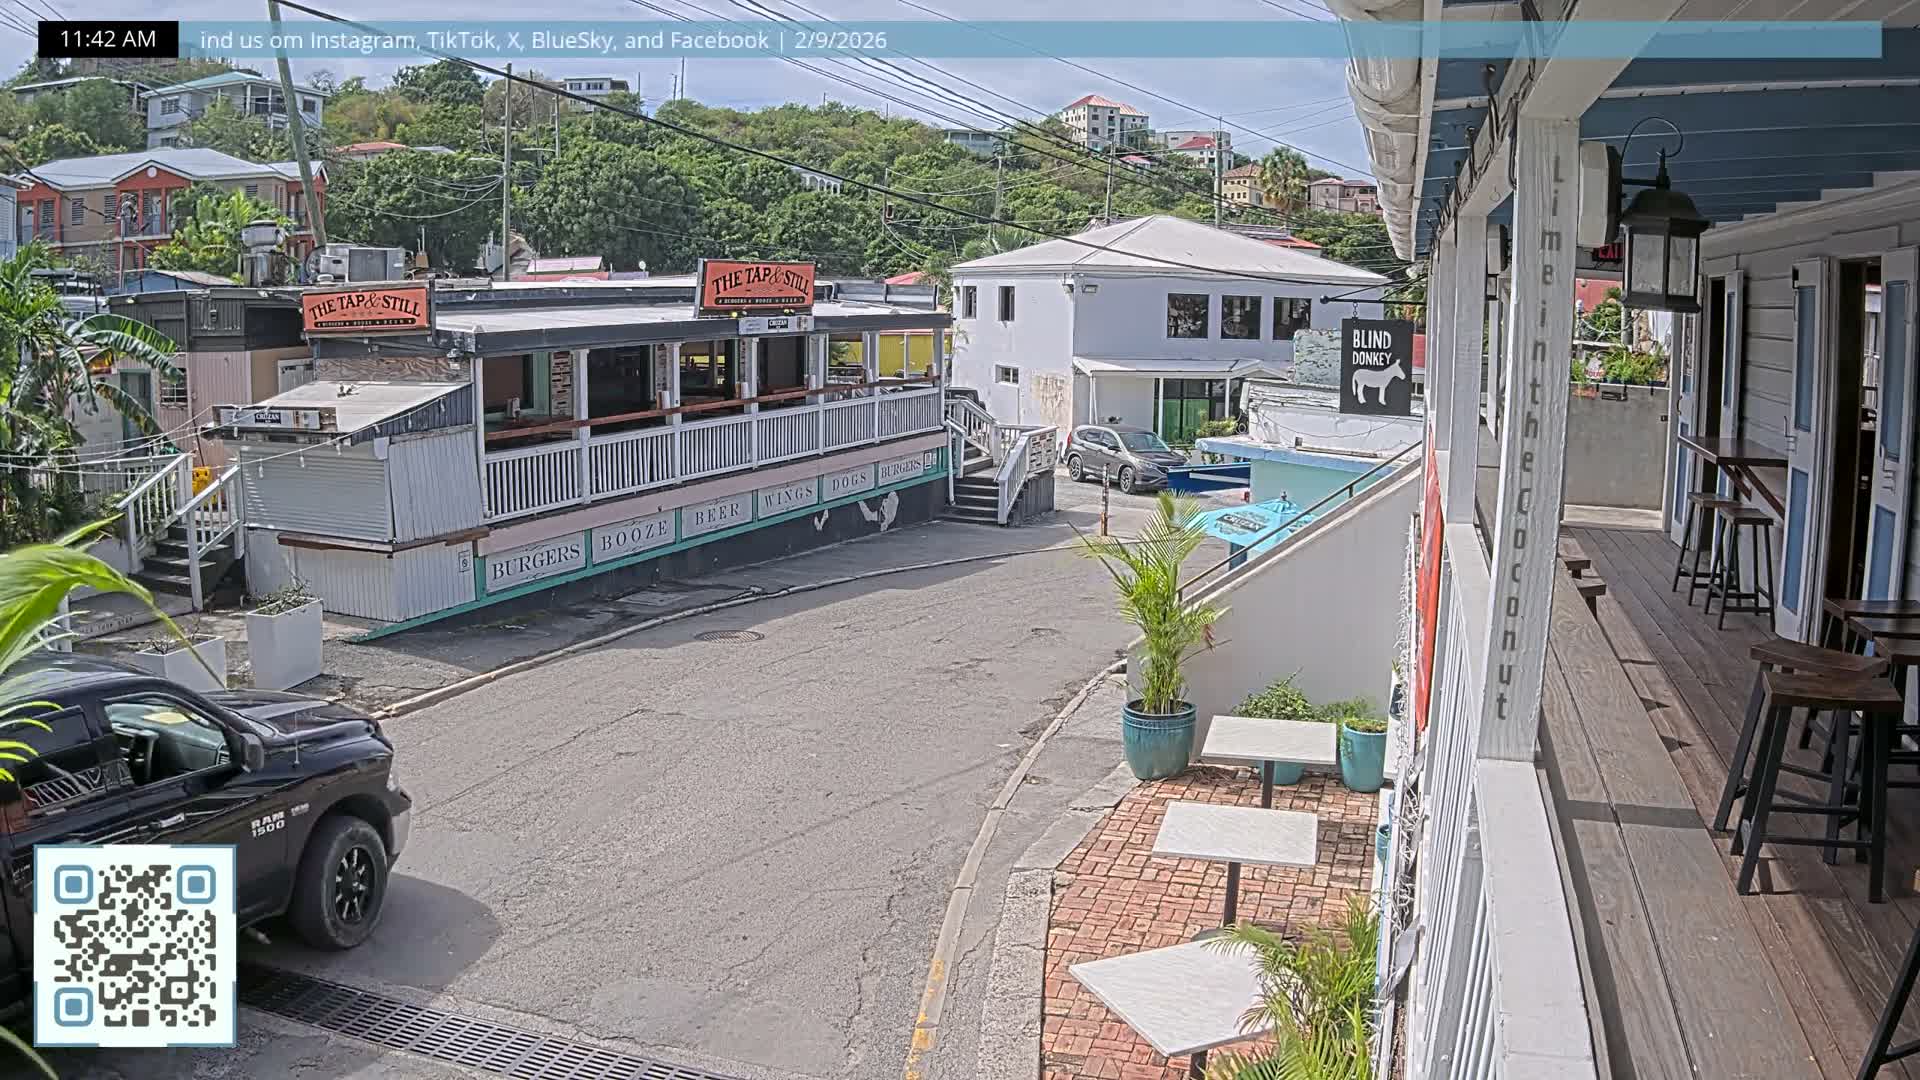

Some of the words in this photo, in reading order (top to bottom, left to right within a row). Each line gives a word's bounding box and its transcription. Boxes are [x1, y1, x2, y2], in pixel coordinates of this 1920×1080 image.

[712, 270, 743, 295] THE
[745, 266, 771, 284] TAP
[783, 270, 809, 296] STILL
[309, 299, 337, 320] THE
[336, 294, 365, 310] TAP
[382, 294, 421, 317] STILL
[1352, 329, 1392, 350] BLIND
[1352, 351, 1392, 366] DONKEY
[880, 459, 922, 479] BURGERS
[832, 472, 867, 491] DOGS
[764, 487, 813, 509] WINGS
[695, 503, 740, 526] BEER
[600, 519, 668, 551] BOOZE
[492, 543, 581, 580] BURGERS
[251, 811, 285, 829] RAM
[252, 820, 285, 838] 1500
